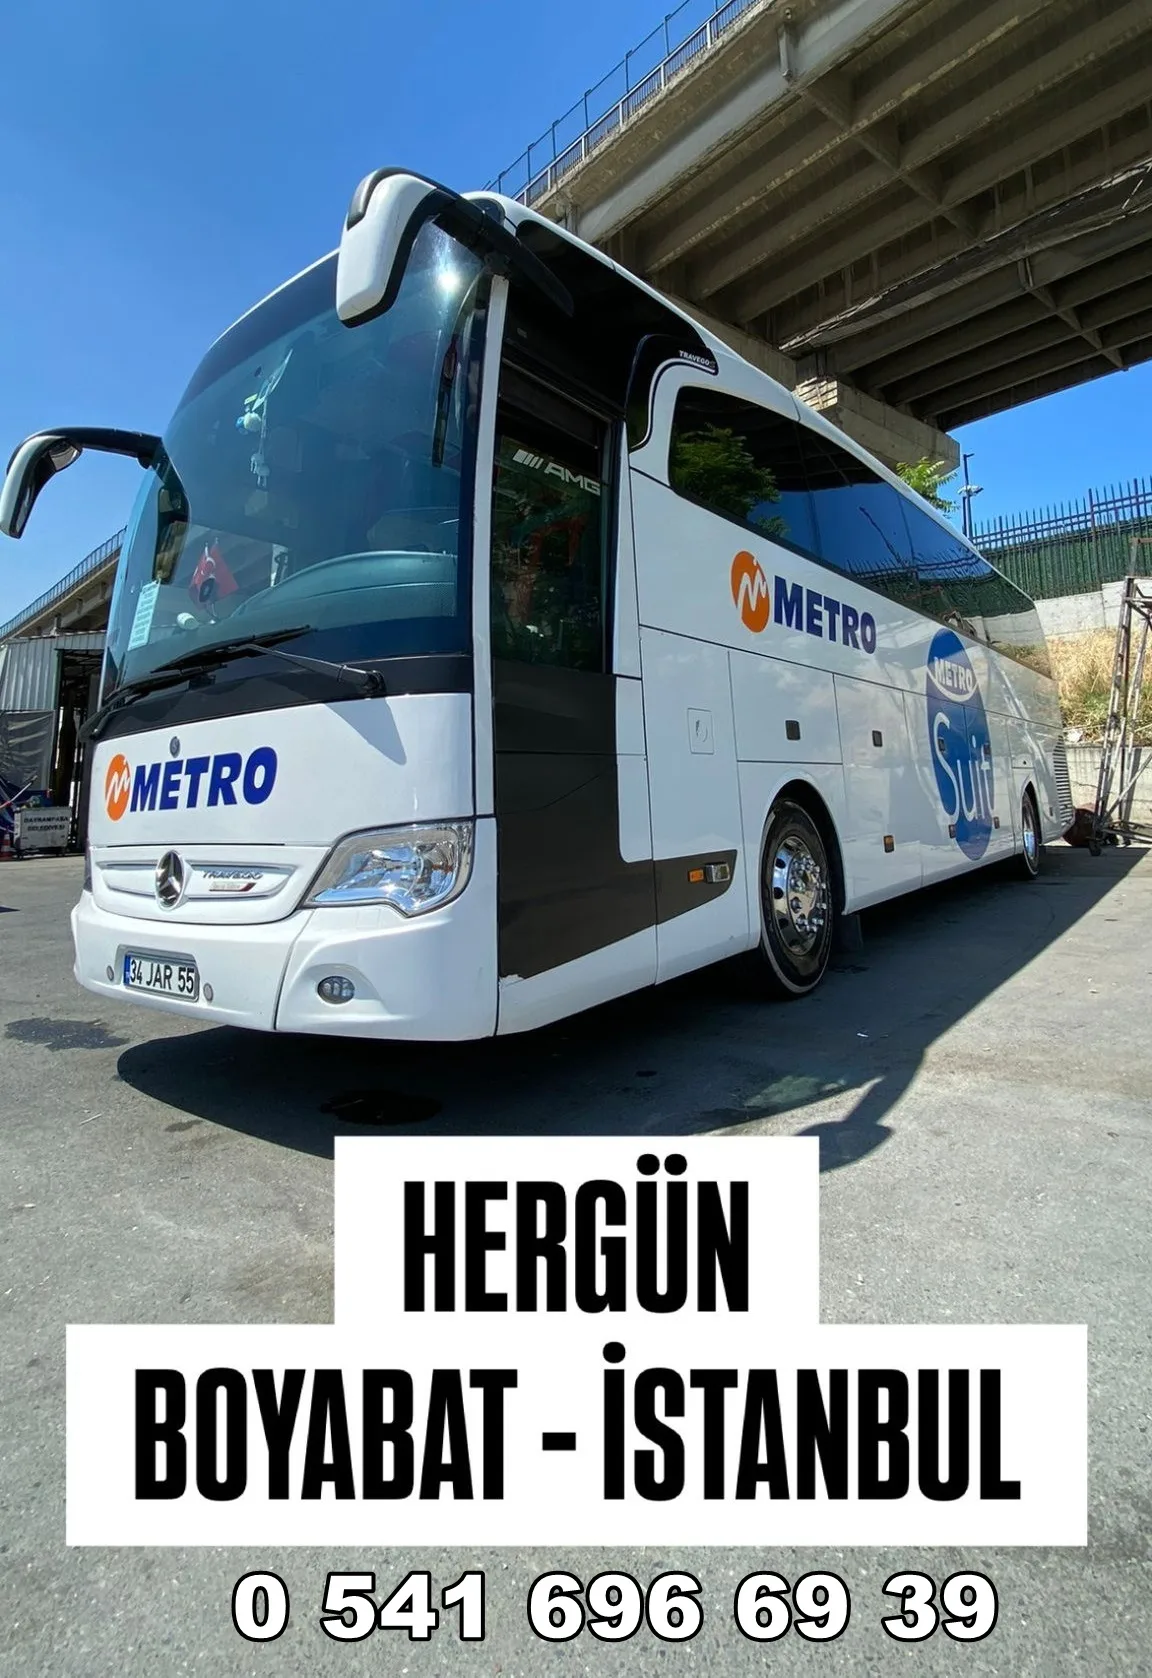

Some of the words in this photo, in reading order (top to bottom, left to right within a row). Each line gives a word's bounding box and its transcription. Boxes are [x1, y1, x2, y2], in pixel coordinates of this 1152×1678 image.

[679, 350, 710, 366] TRAVEGO
[774, 575, 877, 655] METRO
[934, 657, 973, 691] METRO
[130, 746, 278, 813] METRO
[933, 712, 995, 826] Suit
[130, 959, 143, 985] 34
[146, 962, 172, 991] JAR
[178, 966, 195, 994] 55
